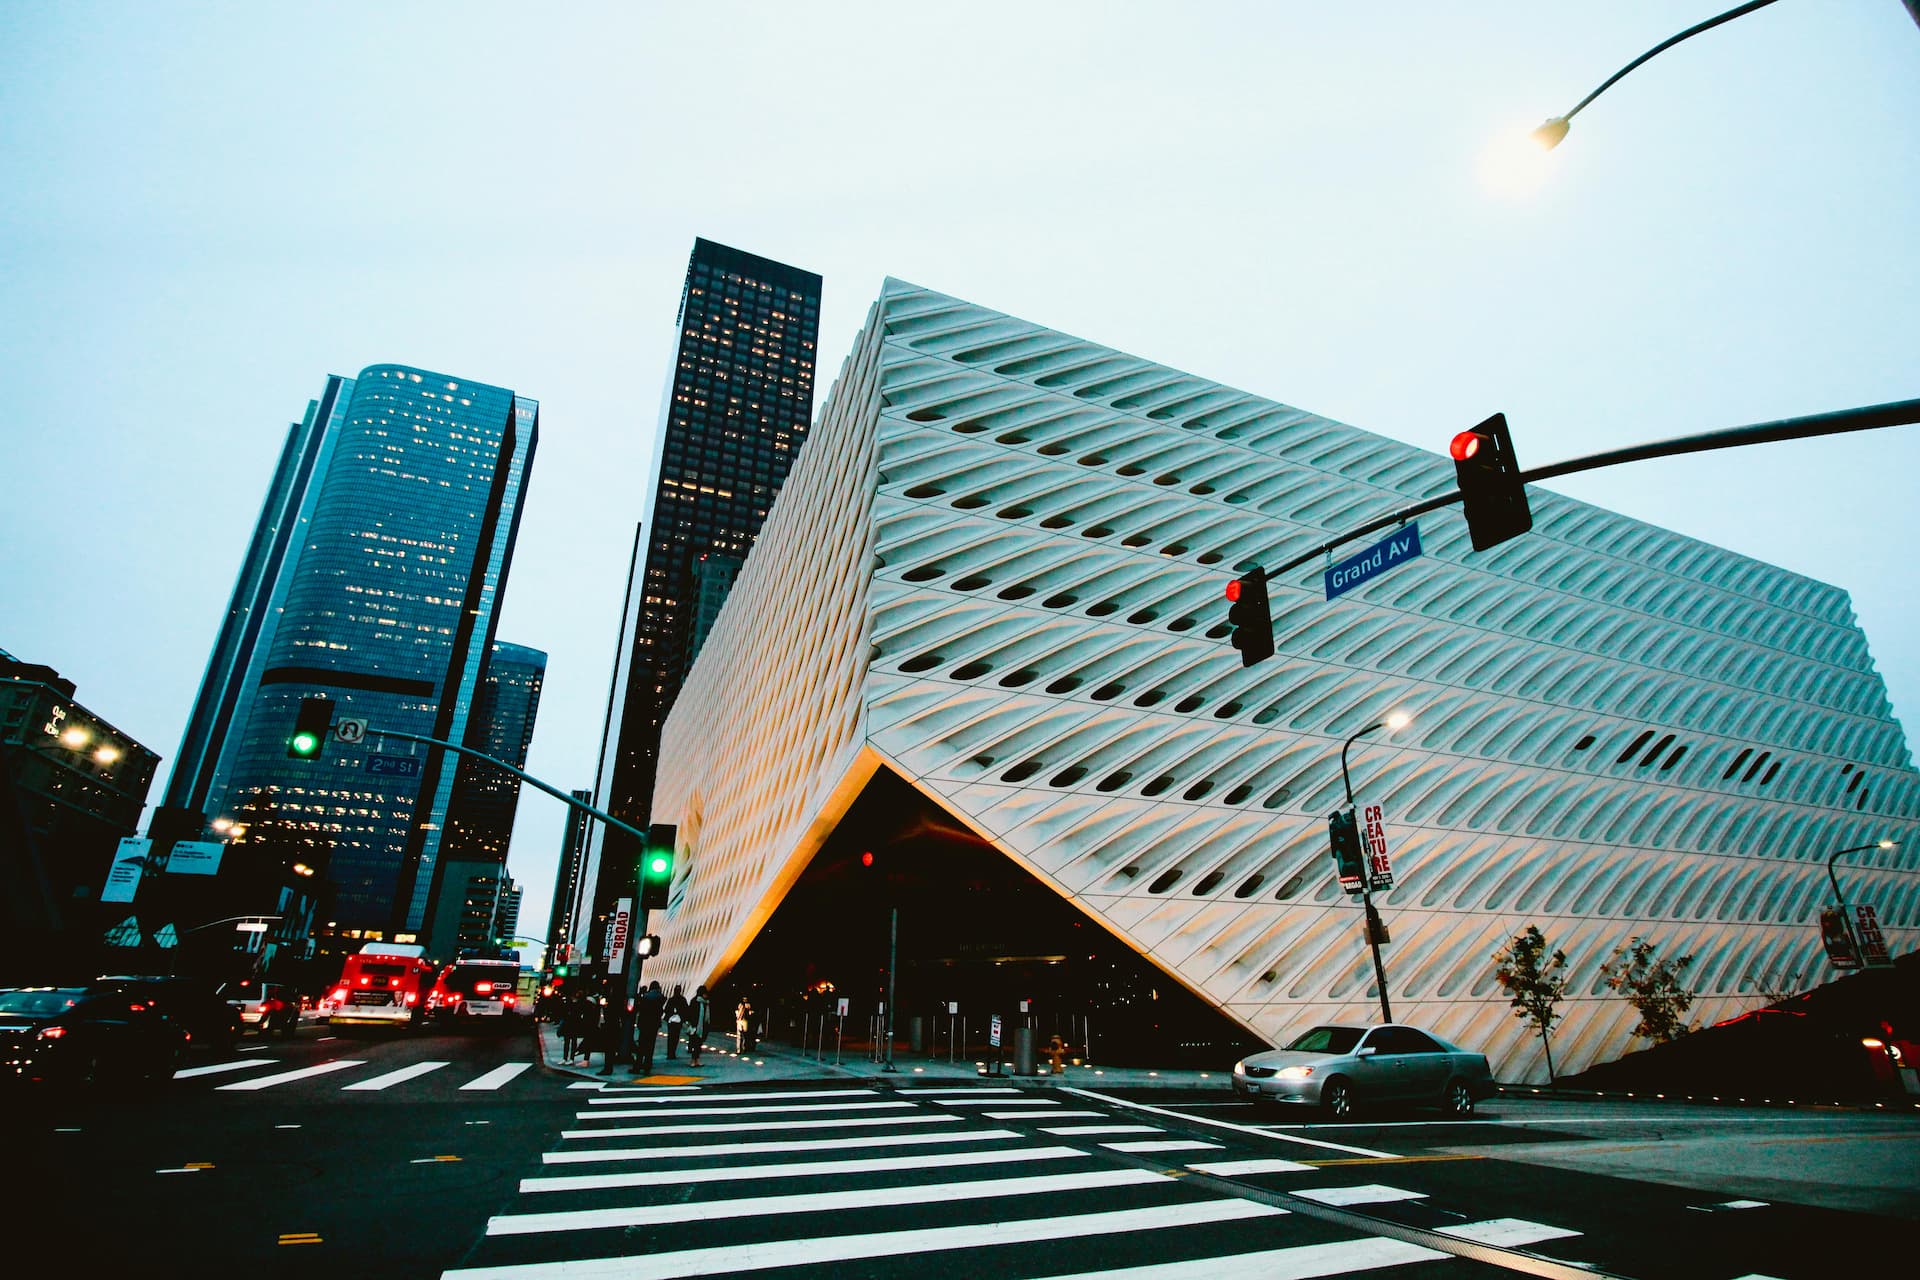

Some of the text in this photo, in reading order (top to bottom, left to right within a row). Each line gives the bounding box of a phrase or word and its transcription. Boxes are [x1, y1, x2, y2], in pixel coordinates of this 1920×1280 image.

[1332, 537, 1410, 588] Grand Av
[372, 758, 413, 773] 2nd St
[1365, 805, 1382, 823] CR
[1367, 822, 1384, 840] EA
[1370, 838, 1386, 855] TU
[1372, 855, 1390, 874] RE
[613, 912, 628, 949] BROAD
